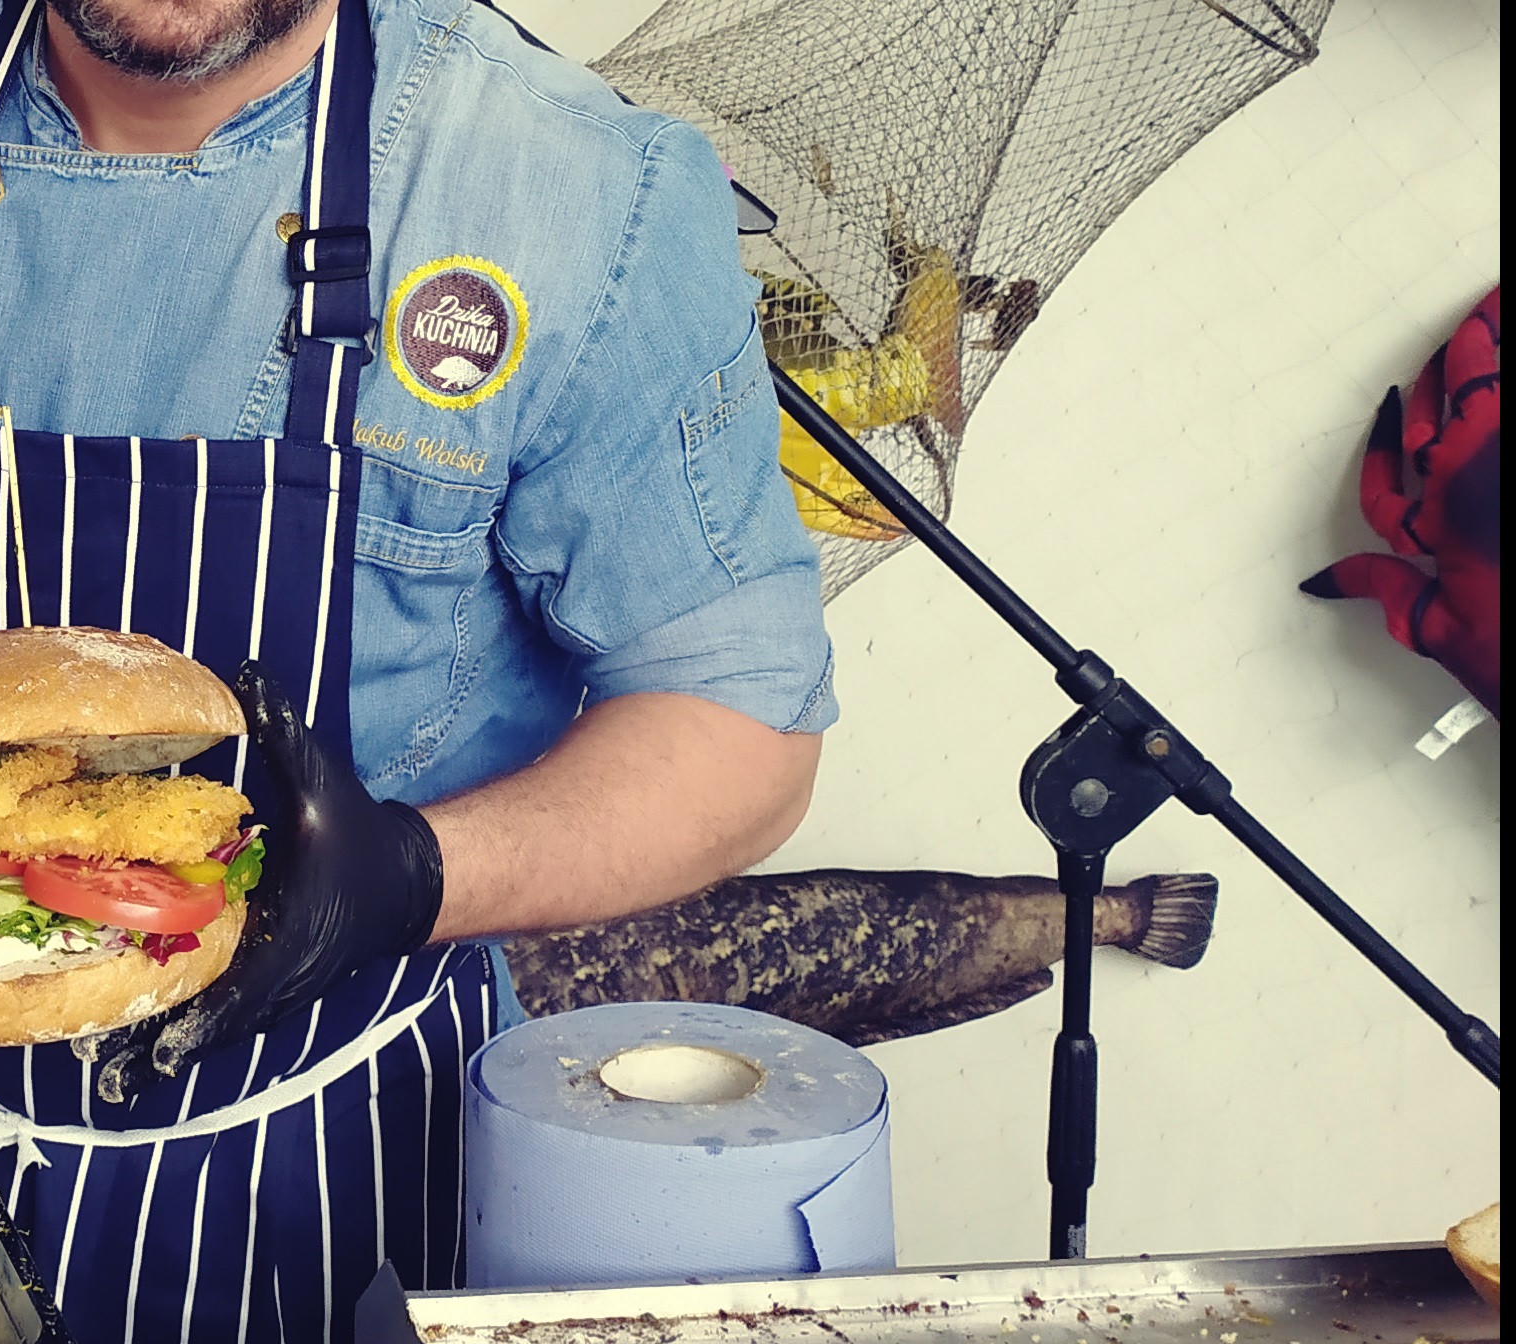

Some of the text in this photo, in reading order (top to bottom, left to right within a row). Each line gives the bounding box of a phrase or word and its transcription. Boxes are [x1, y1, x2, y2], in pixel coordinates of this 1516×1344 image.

[427, 296, 496, 327] Dzika
[413, 312, 498, 355] KUCHNIA
[415, 437, 488, 476] Wolski
